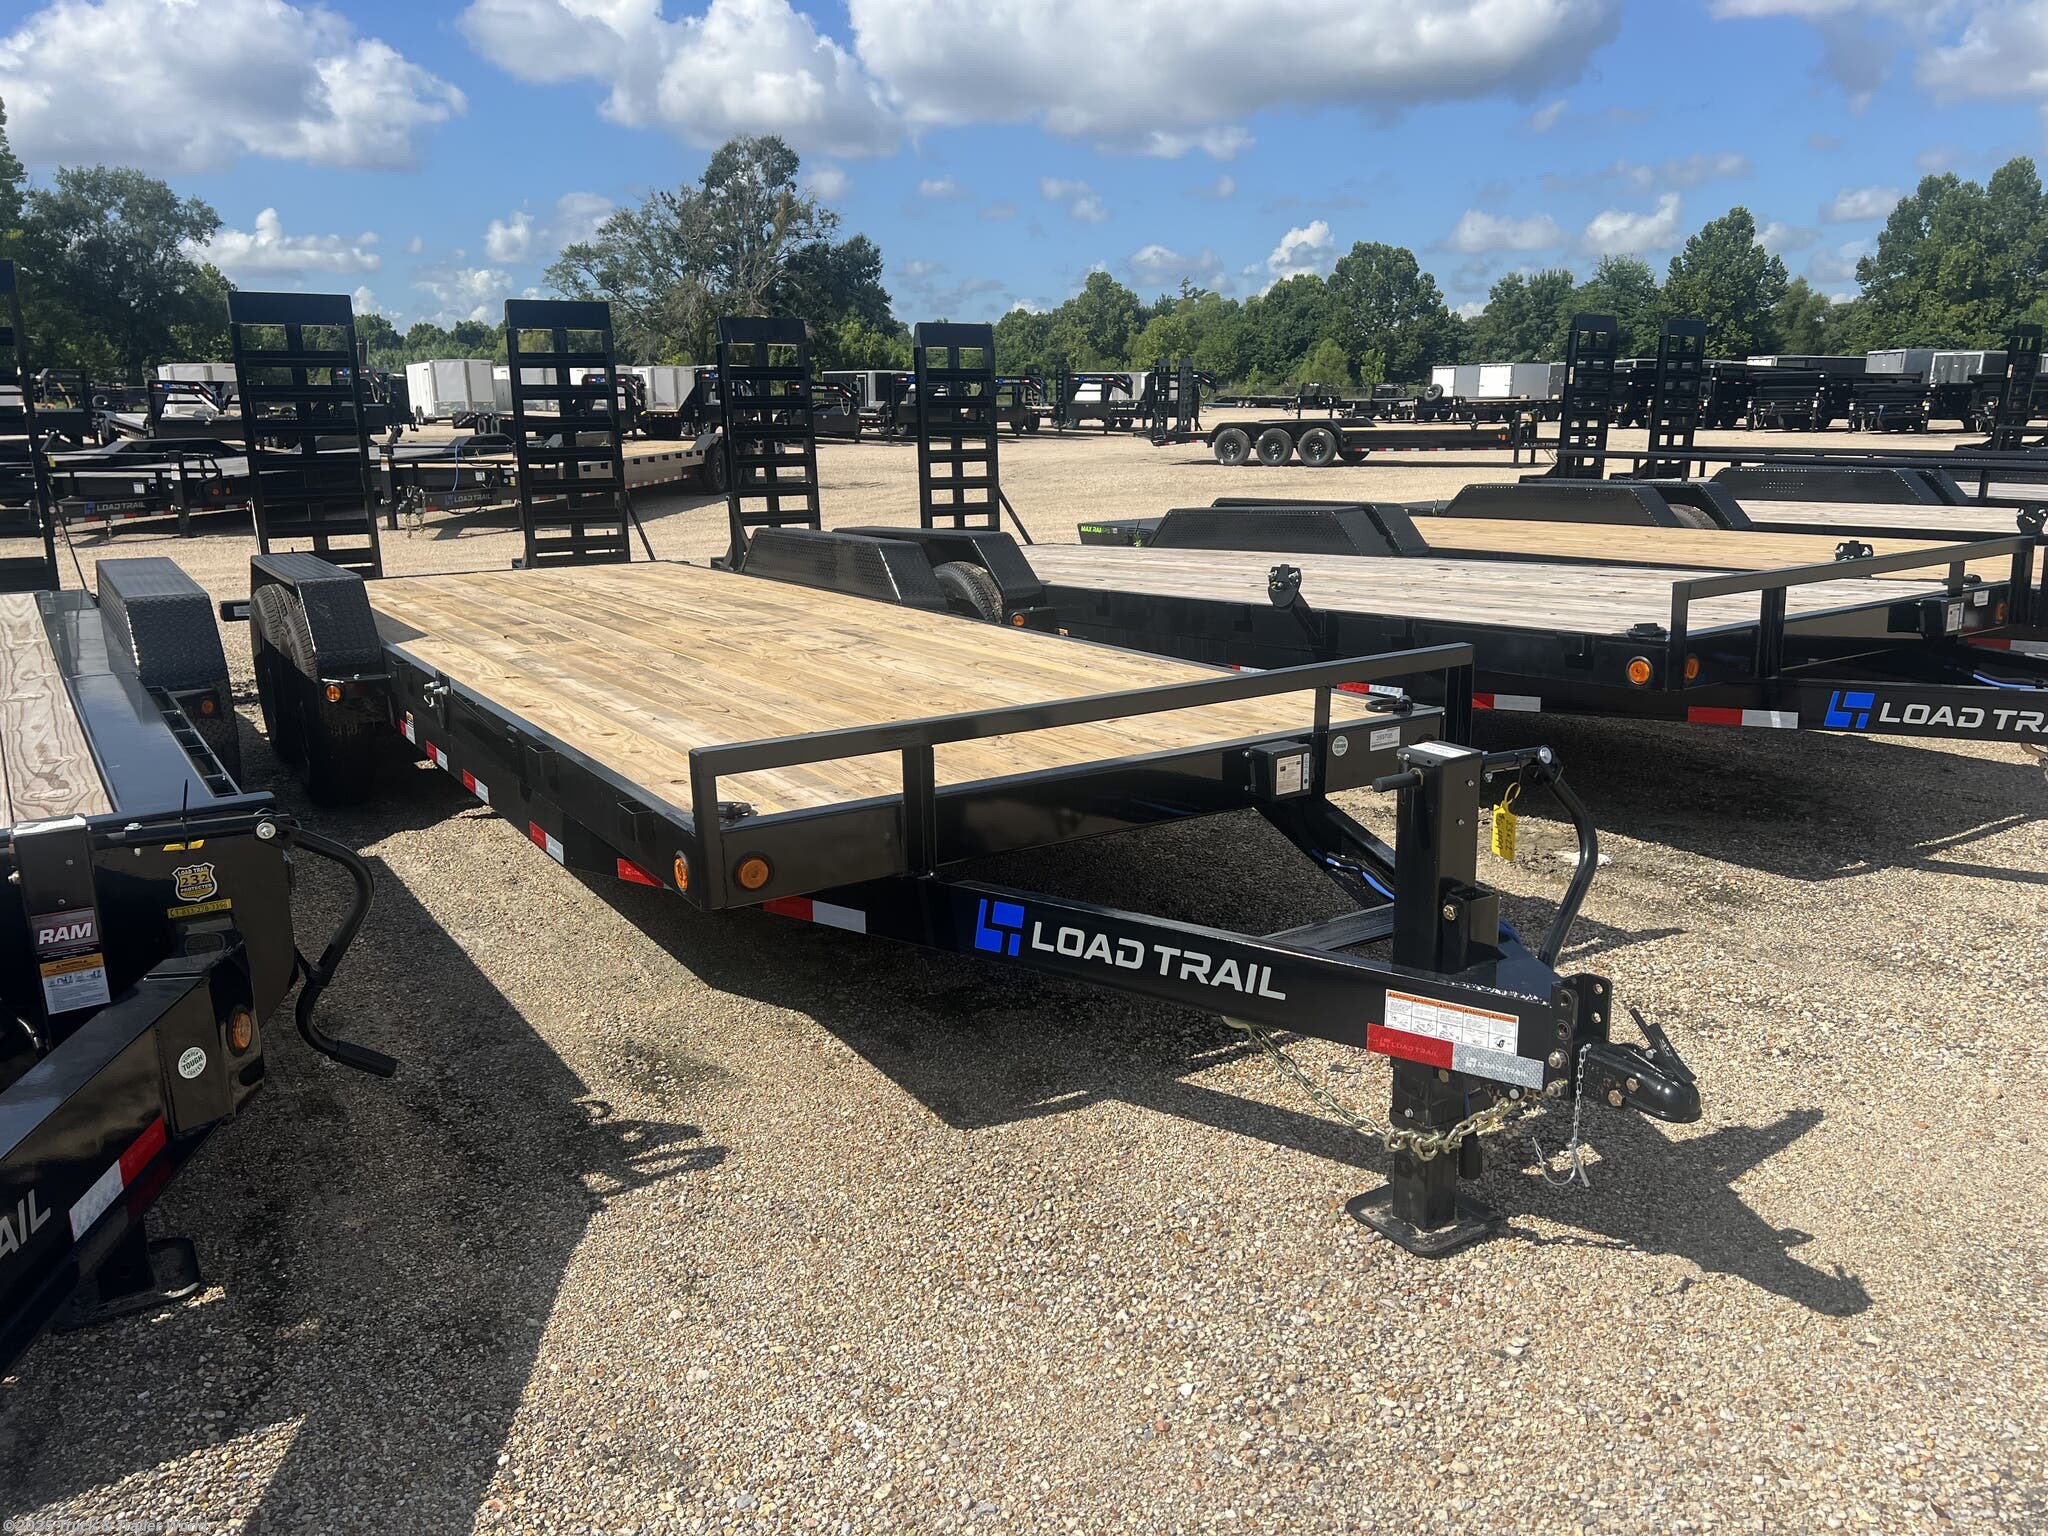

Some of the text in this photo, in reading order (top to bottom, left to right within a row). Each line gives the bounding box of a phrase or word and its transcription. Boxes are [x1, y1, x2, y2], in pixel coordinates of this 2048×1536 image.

[453, 493, 492, 503] LOAD TRAIL
[96, 501, 146, 512] LOAD TRAIL
[1878, 702, 1985, 728] LOAD
[181, 873, 209, 886] 232
[180, 883, 213, 893] PROTECTED
[39, 922, 92, 945] RAM
[1031, 921, 1287, 1001] LOAD TRAIL
[1391, 1042, 1439, 1058] LOAD TRAIL
[182, 1054, 203, 1071] TOUGH
[1477, 1061, 1529, 1078] LOAD TRAIL
